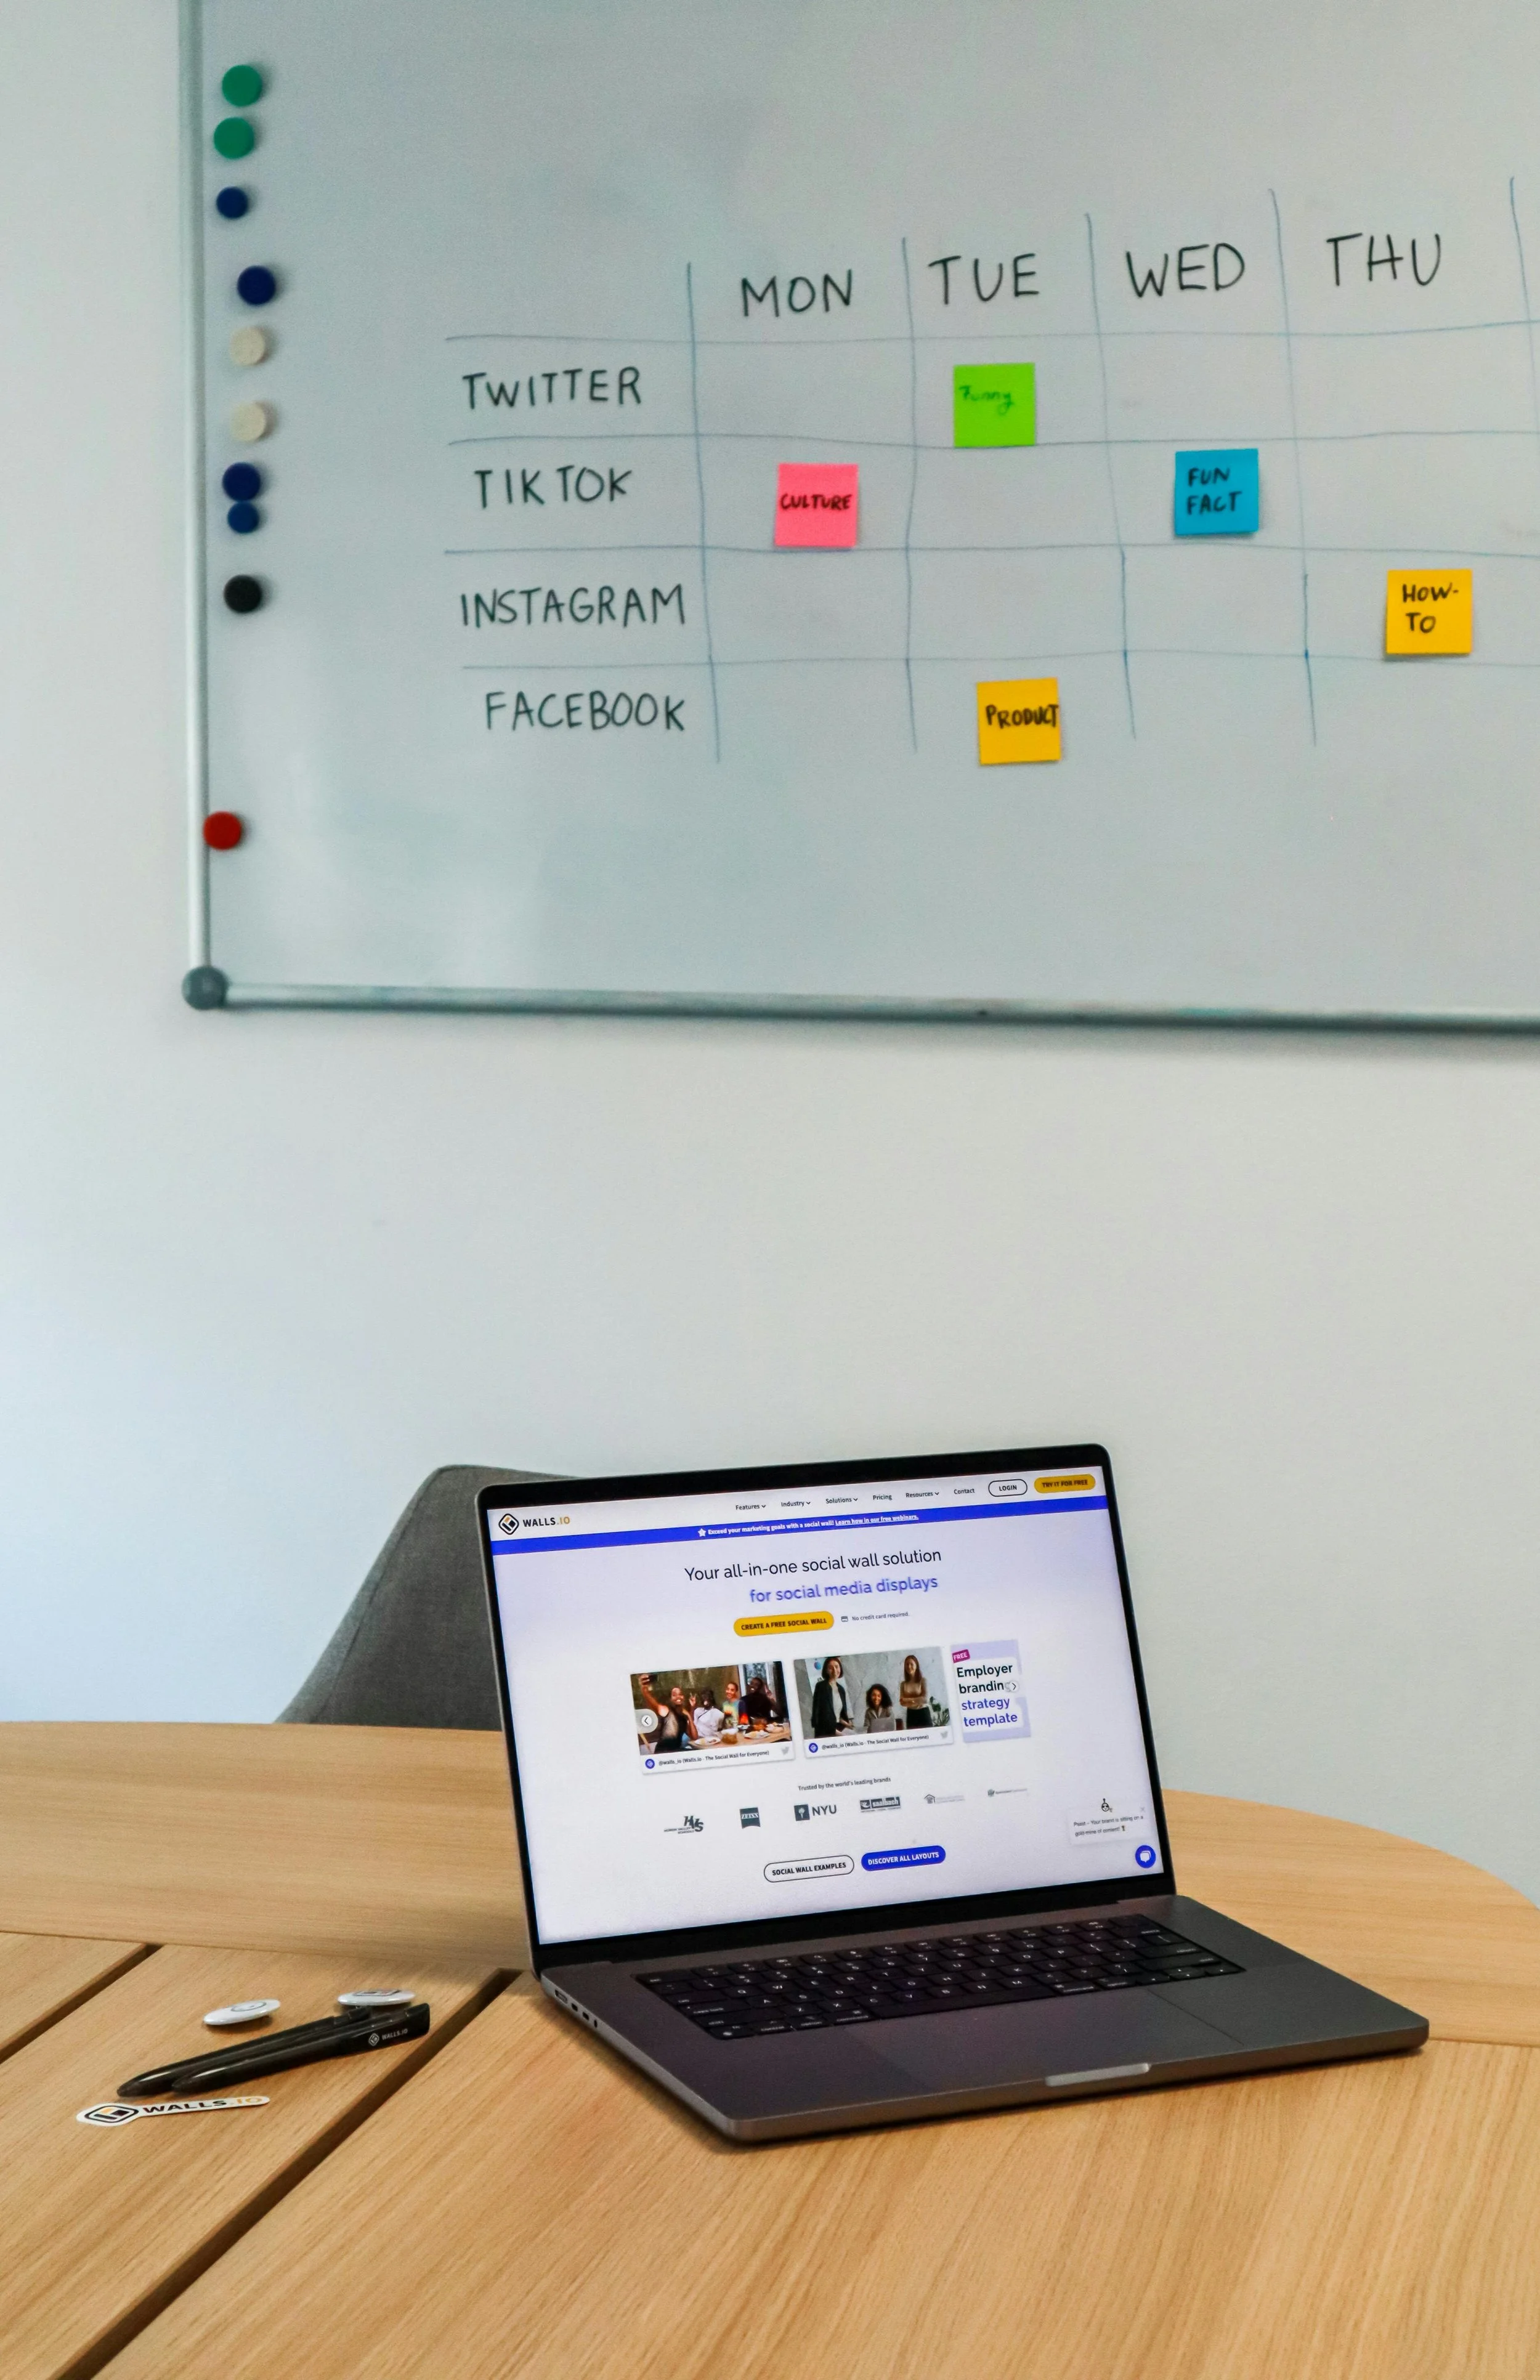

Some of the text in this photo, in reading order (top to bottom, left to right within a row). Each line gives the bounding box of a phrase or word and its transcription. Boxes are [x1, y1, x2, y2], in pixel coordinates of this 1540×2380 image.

[740, 233, 1441, 317] MON TUE WED THU
[463, 366, 642, 410] TWITTER
[1188, 466, 1231, 487] FUN
[779, 493, 852, 511] CULTURE
[1186, 490, 1242, 515] FACT
[1401, 583, 1459, 604] HOW-
[461, 583, 686, 628] INSTAGRAM
[1406, 612, 1436, 633] TO
[485, 691, 685, 731] FACEBOOK
[986, 703, 1060, 729] PRODUCT
[522, 1516, 570, 1528] WALLS.IO
[684, 1548, 942, 1581] Your all-in-one social wall solution
[750, 1576, 938, 1603] for social media displays
[953, 1651, 968, 1661] FREE
[957, 1665, 1013, 1678] Employer
[962, 1698, 1010, 1710] strategy
[963, 1713, 1018, 1727] template
[812, 1805, 837, 1816] NYU
[772, 1861, 846, 1876] SOCIAL WALL EXAMPLES
[868, 1852, 939, 1866] DISCOVER ALL LAYOUTS
[382, 2028, 408, 2040] WALLS.IO
[143, 2097, 262, 2114] WALLS.IO
